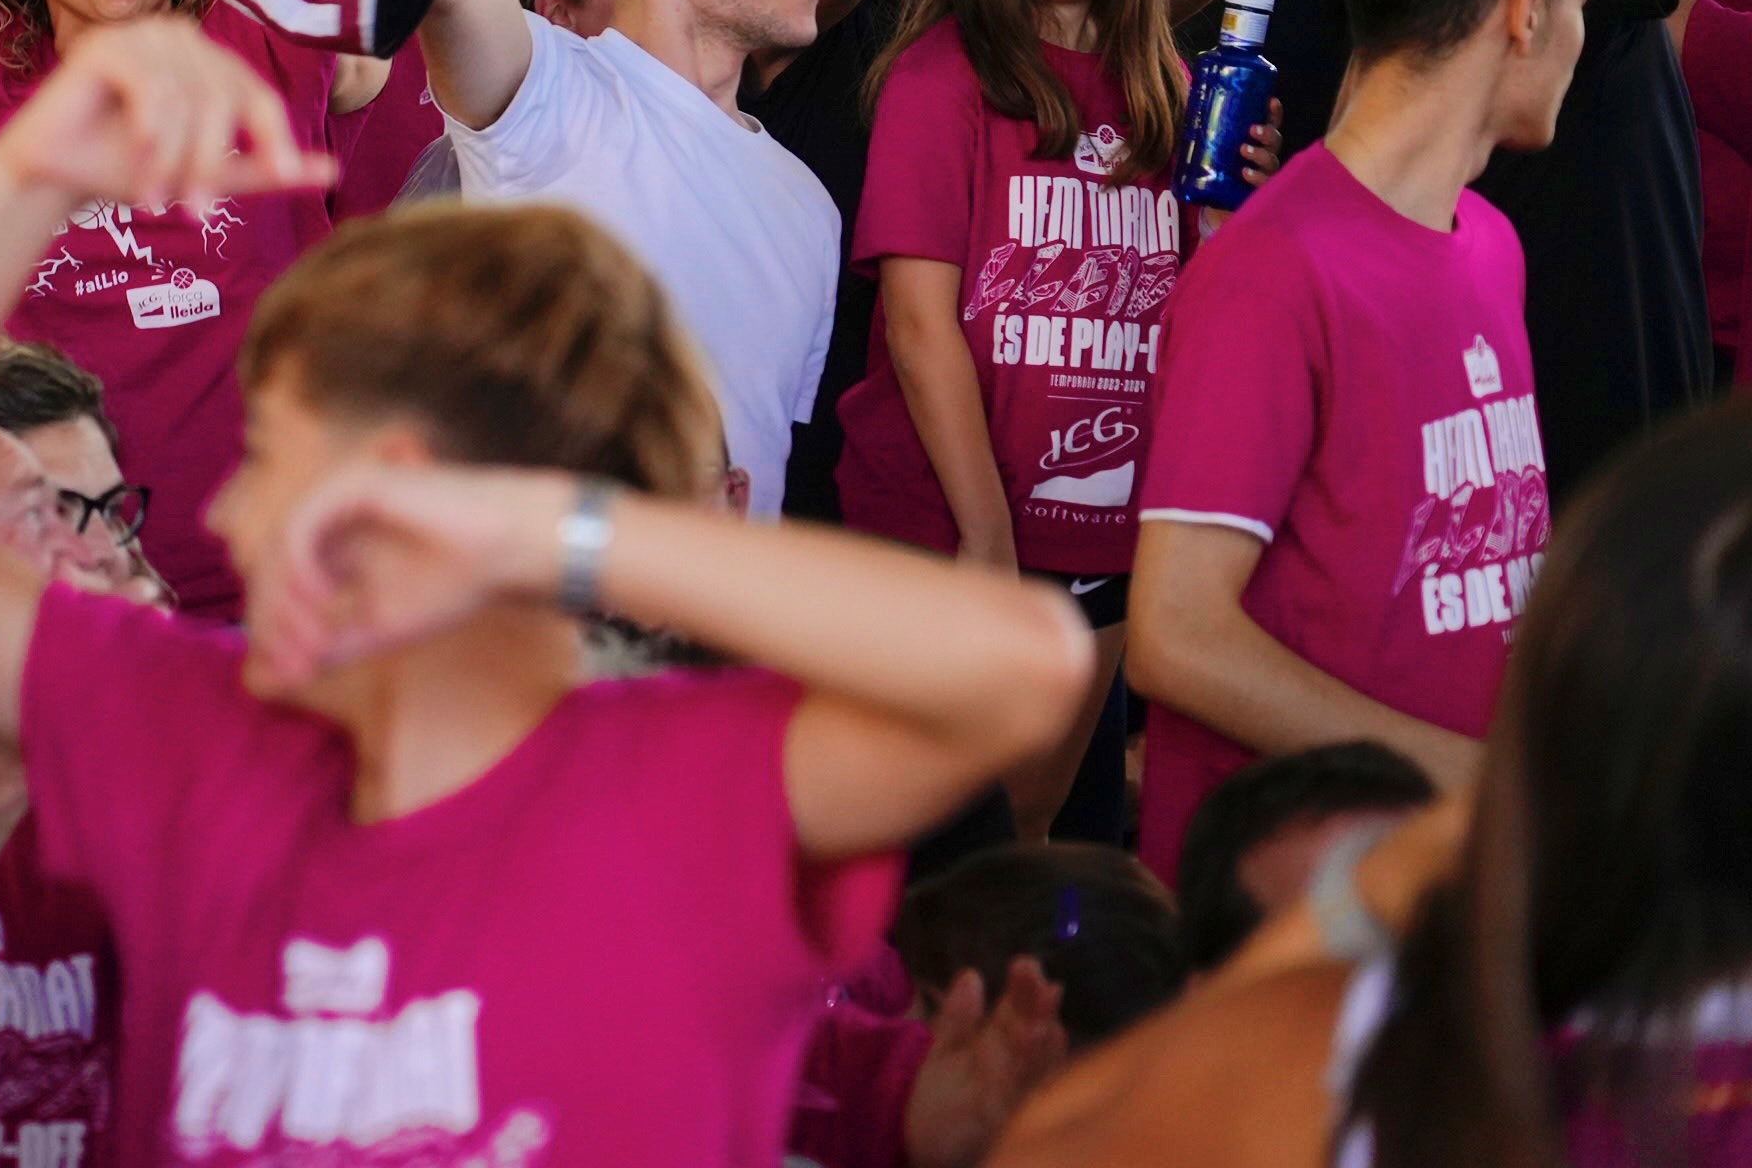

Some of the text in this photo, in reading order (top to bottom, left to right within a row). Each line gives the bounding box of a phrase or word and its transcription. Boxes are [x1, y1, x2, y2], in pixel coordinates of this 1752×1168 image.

[1009, 175, 1180, 257] HEM TORNA
[170, 301, 214, 319] lleida
[964, 243, 1179, 320] LLEID
[993, 302, 1023, 365] ÉS
[1025, 315, 1067, 367] DE
[1050, 406, 1124, 463] ICG
[1422, 562, 1465, 635] ÉS
[1463, 563, 1512, 627] DE
